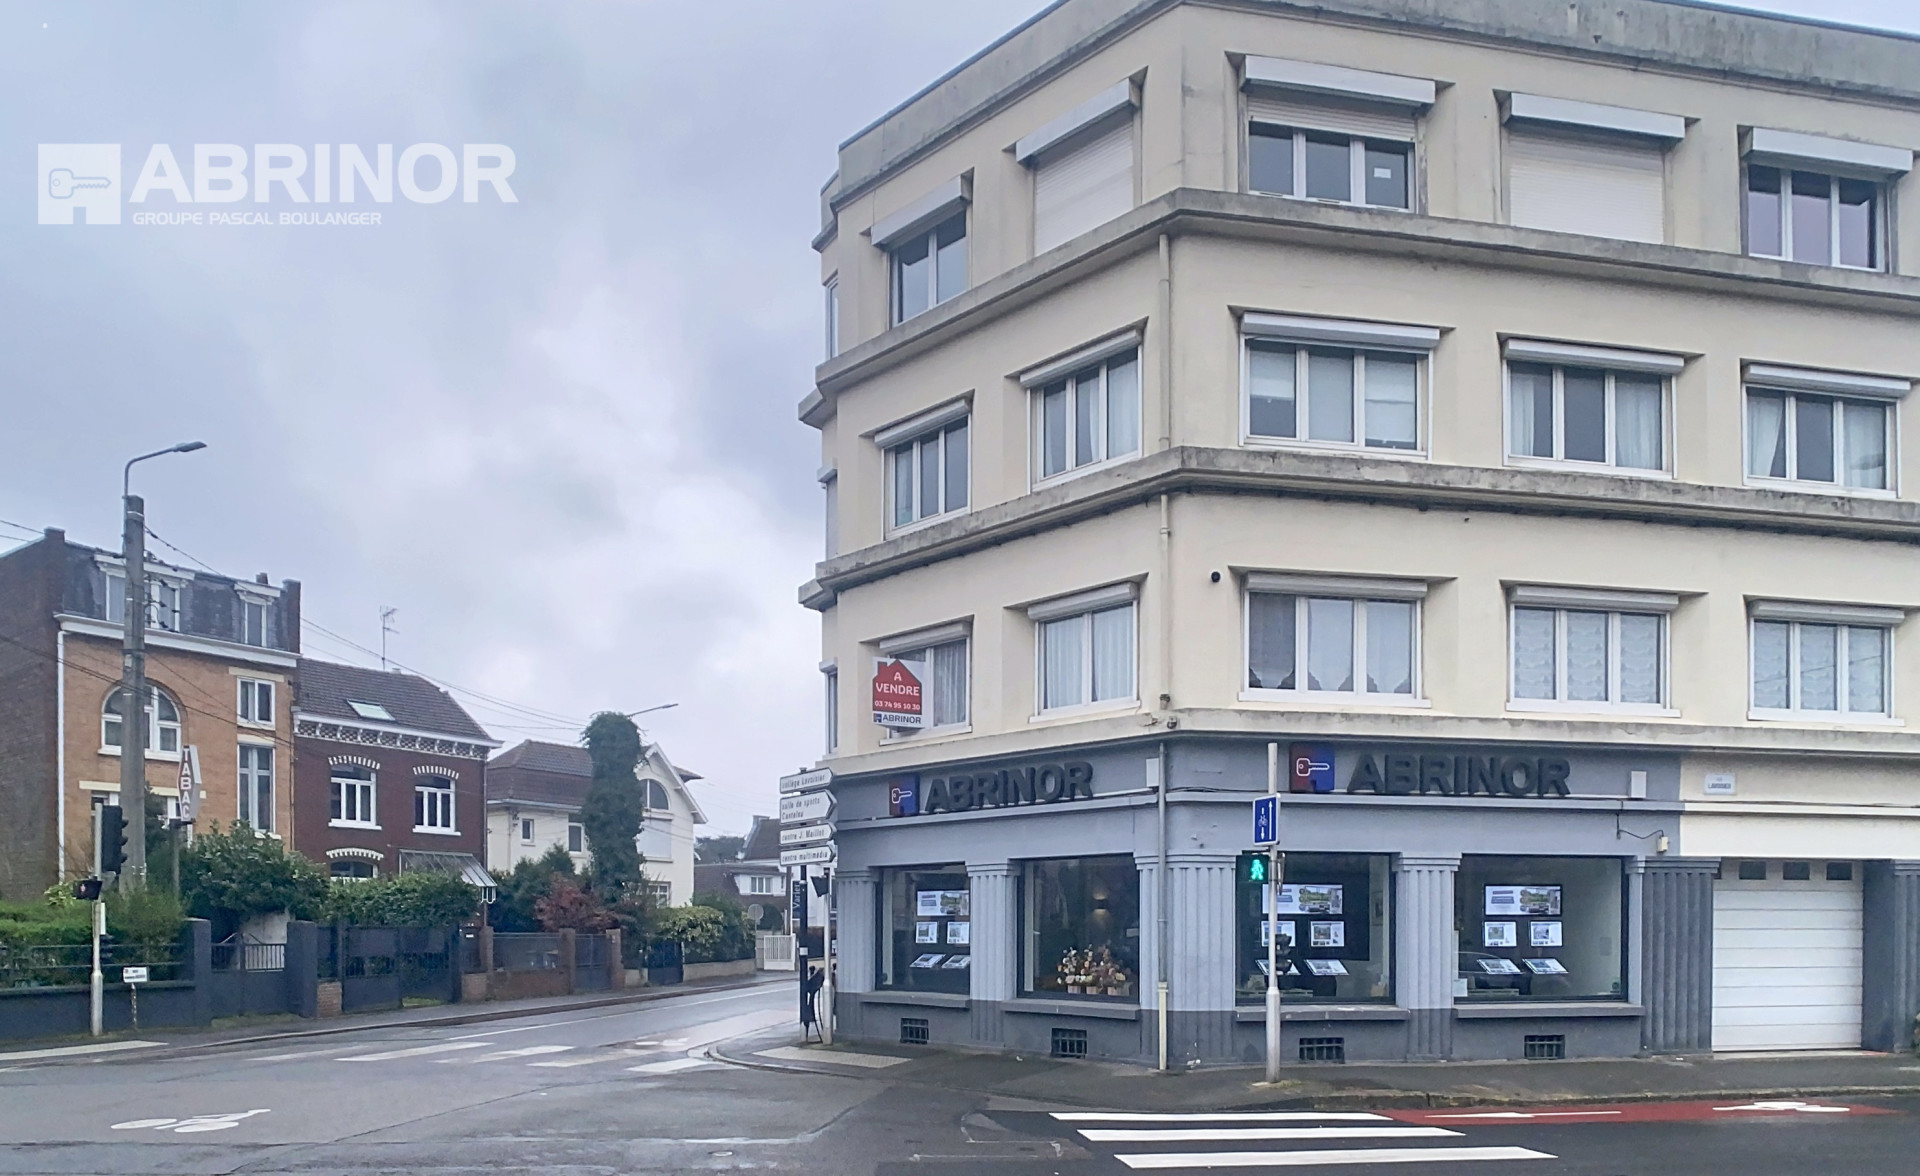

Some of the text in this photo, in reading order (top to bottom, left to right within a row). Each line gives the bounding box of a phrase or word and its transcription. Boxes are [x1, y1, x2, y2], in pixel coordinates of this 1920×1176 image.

[894, 672, 901, 681] A
[875, 682, 920, 696] VENDRE
[882, 714, 922, 724] ABRINOR
[1347, 754, 1571, 798] ABRINOR
[181, 749, 191, 818] TABAC
[925, 761, 1093, 813] ABRINOR
[795, 800, 802, 808] de
